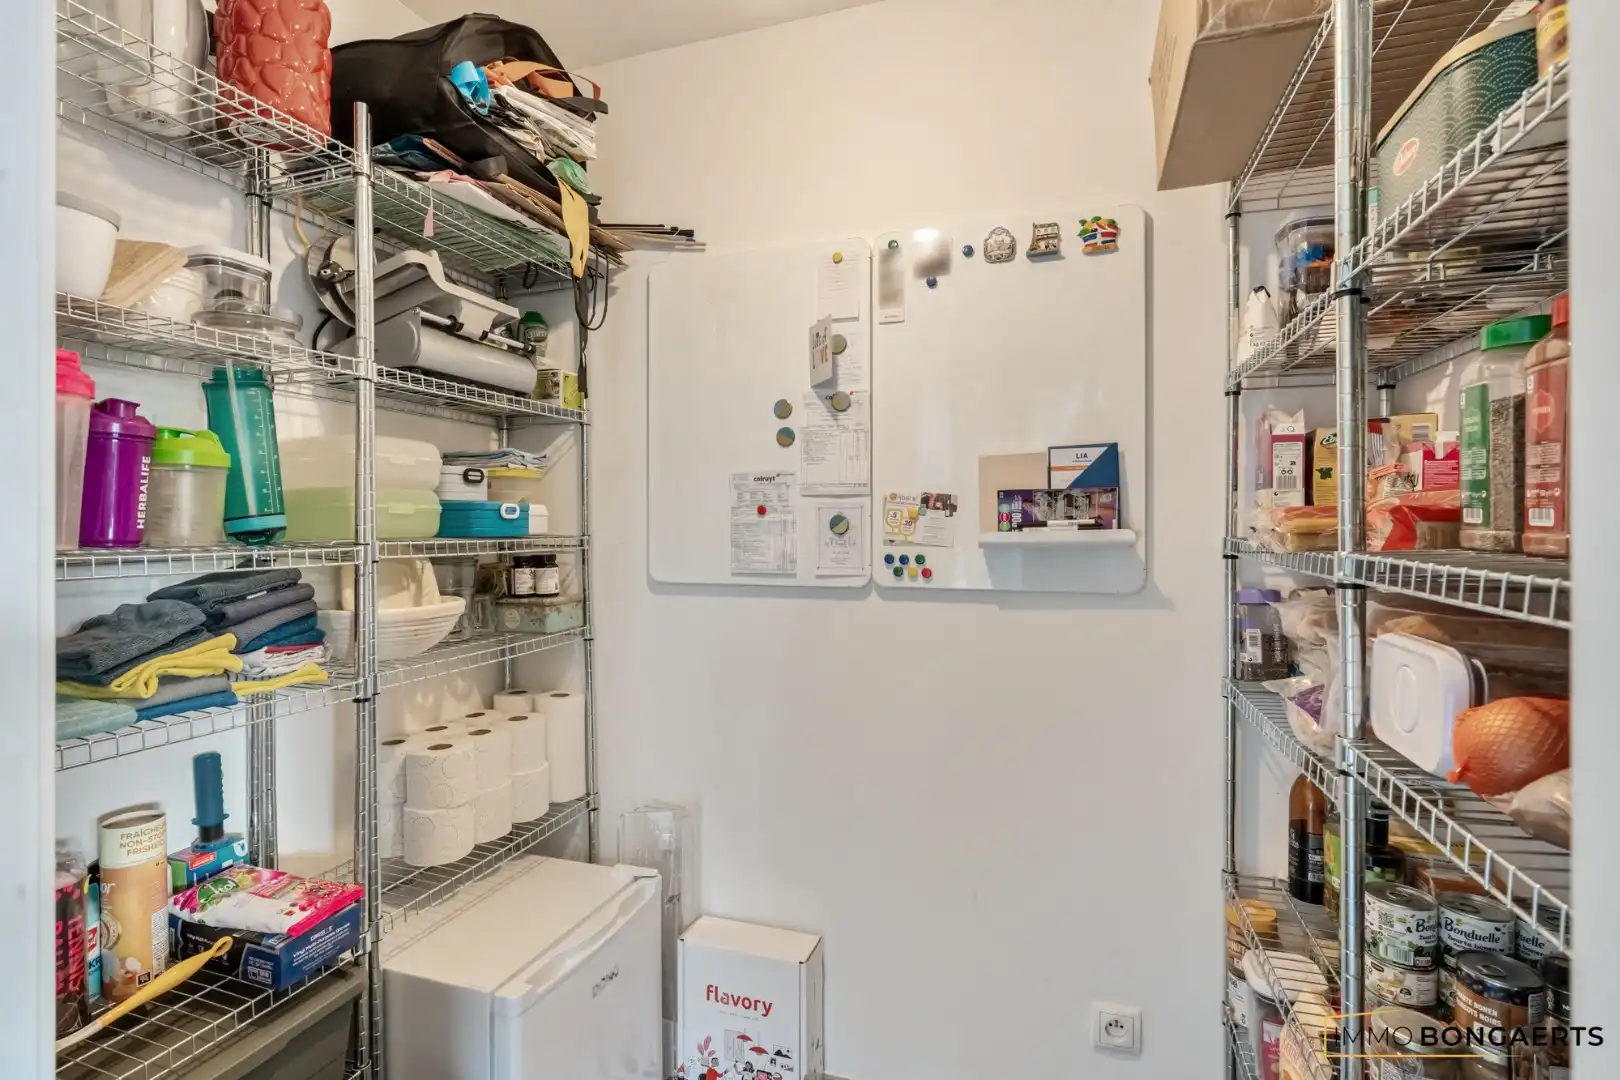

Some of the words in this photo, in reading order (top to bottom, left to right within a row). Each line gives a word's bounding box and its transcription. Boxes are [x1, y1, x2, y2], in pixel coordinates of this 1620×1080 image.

[137, 456, 151, 529] HERBALIFE
[119, 831, 165, 849] NON-STO
[1443, 917, 1501, 944] Bonduelle
[706, 984, 773, 1017] flavory
